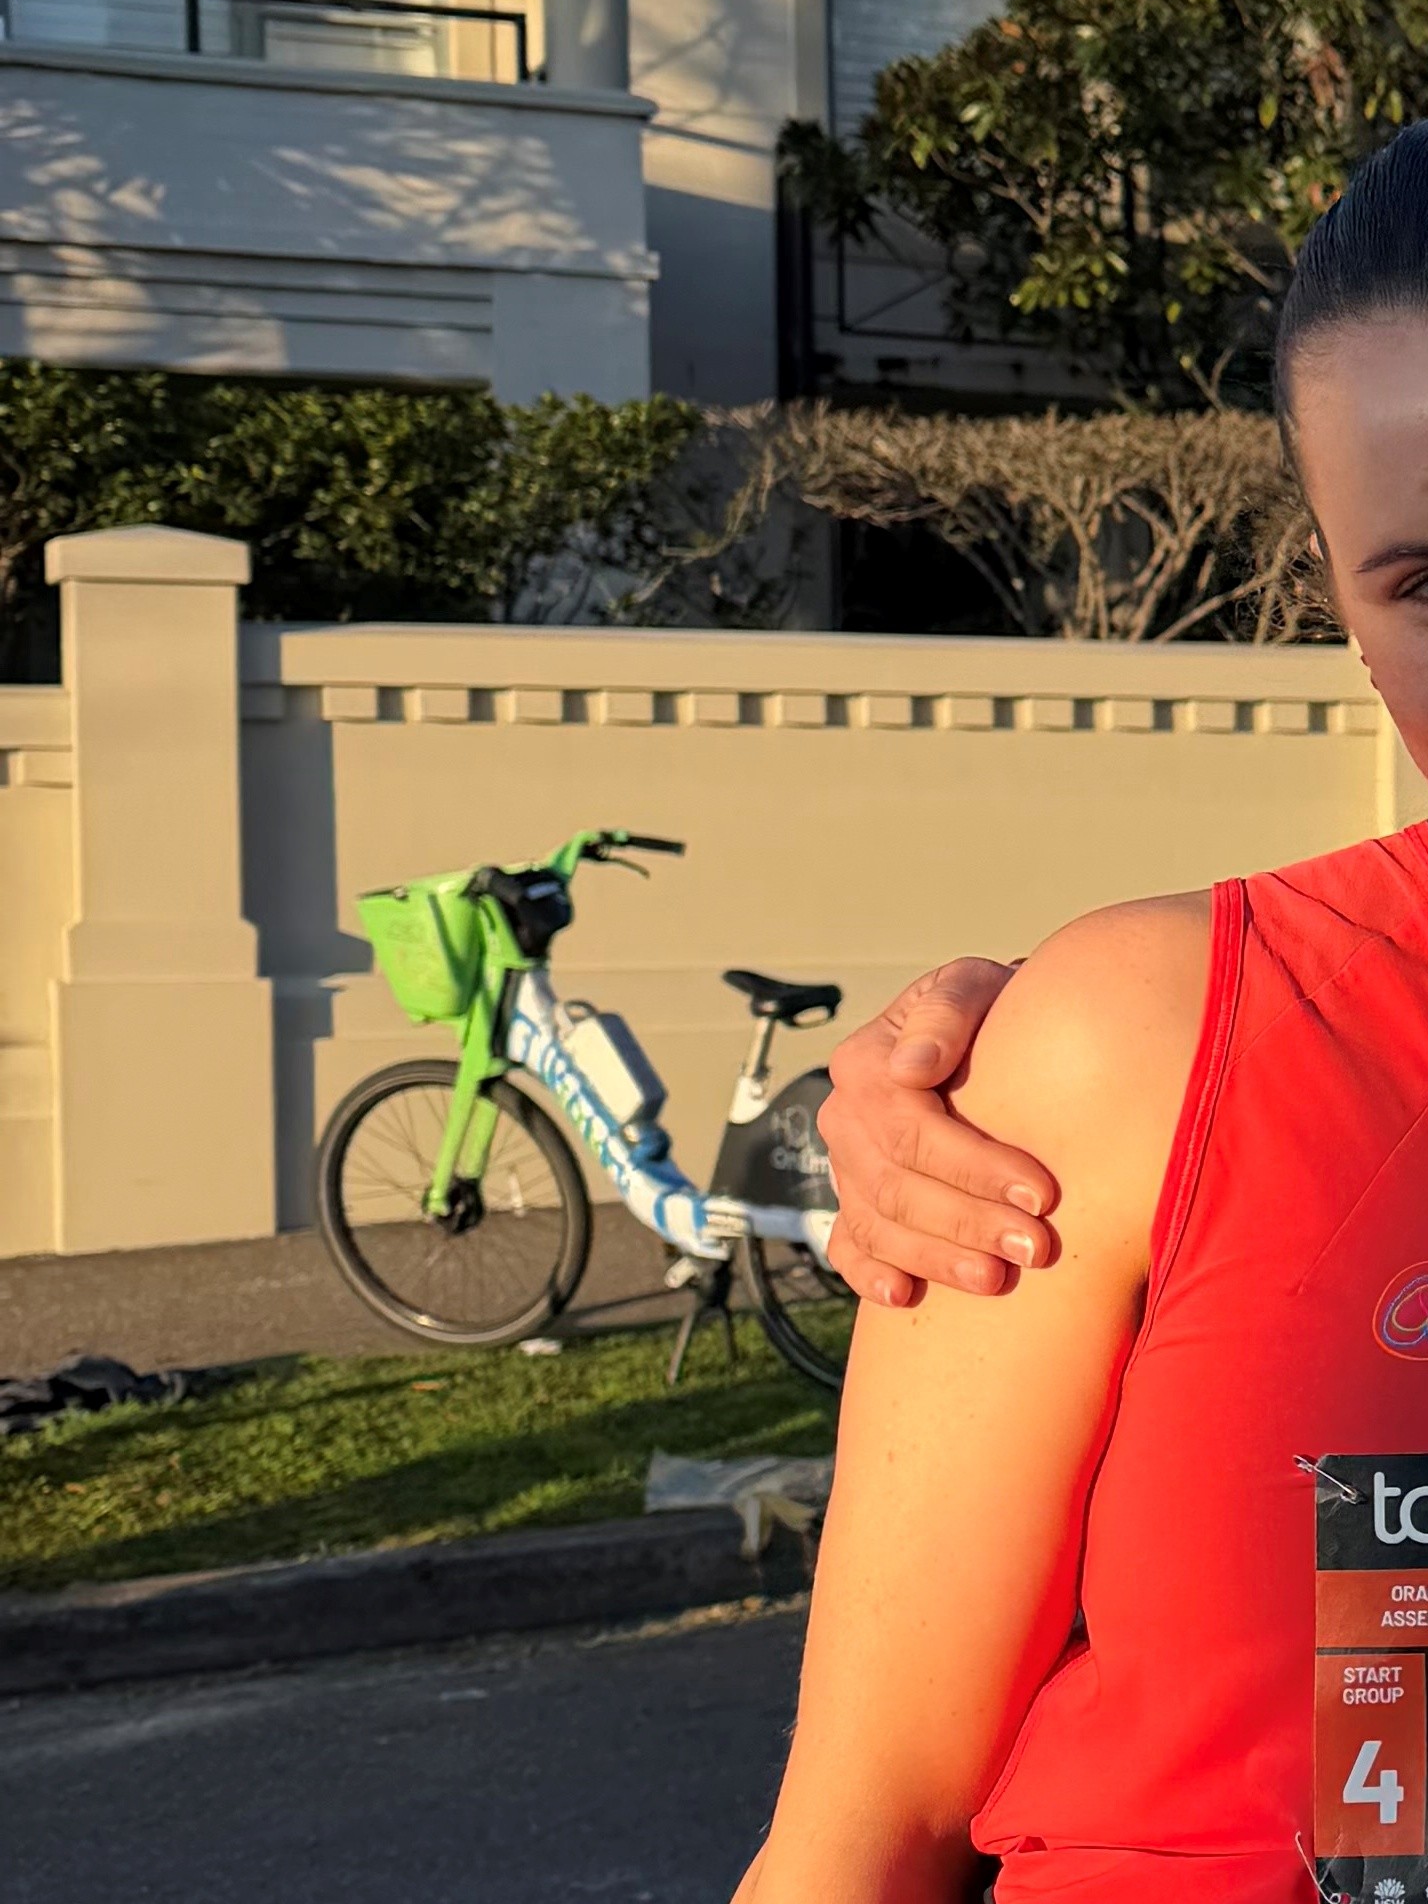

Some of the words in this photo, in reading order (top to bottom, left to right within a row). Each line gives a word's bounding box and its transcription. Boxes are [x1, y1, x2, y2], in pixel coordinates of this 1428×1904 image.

[1343, 1666, 1403, 1684] START
[1342, 1687, 1404, 1705] GROUP
[1342, 1740, 1404, 1824] 4
